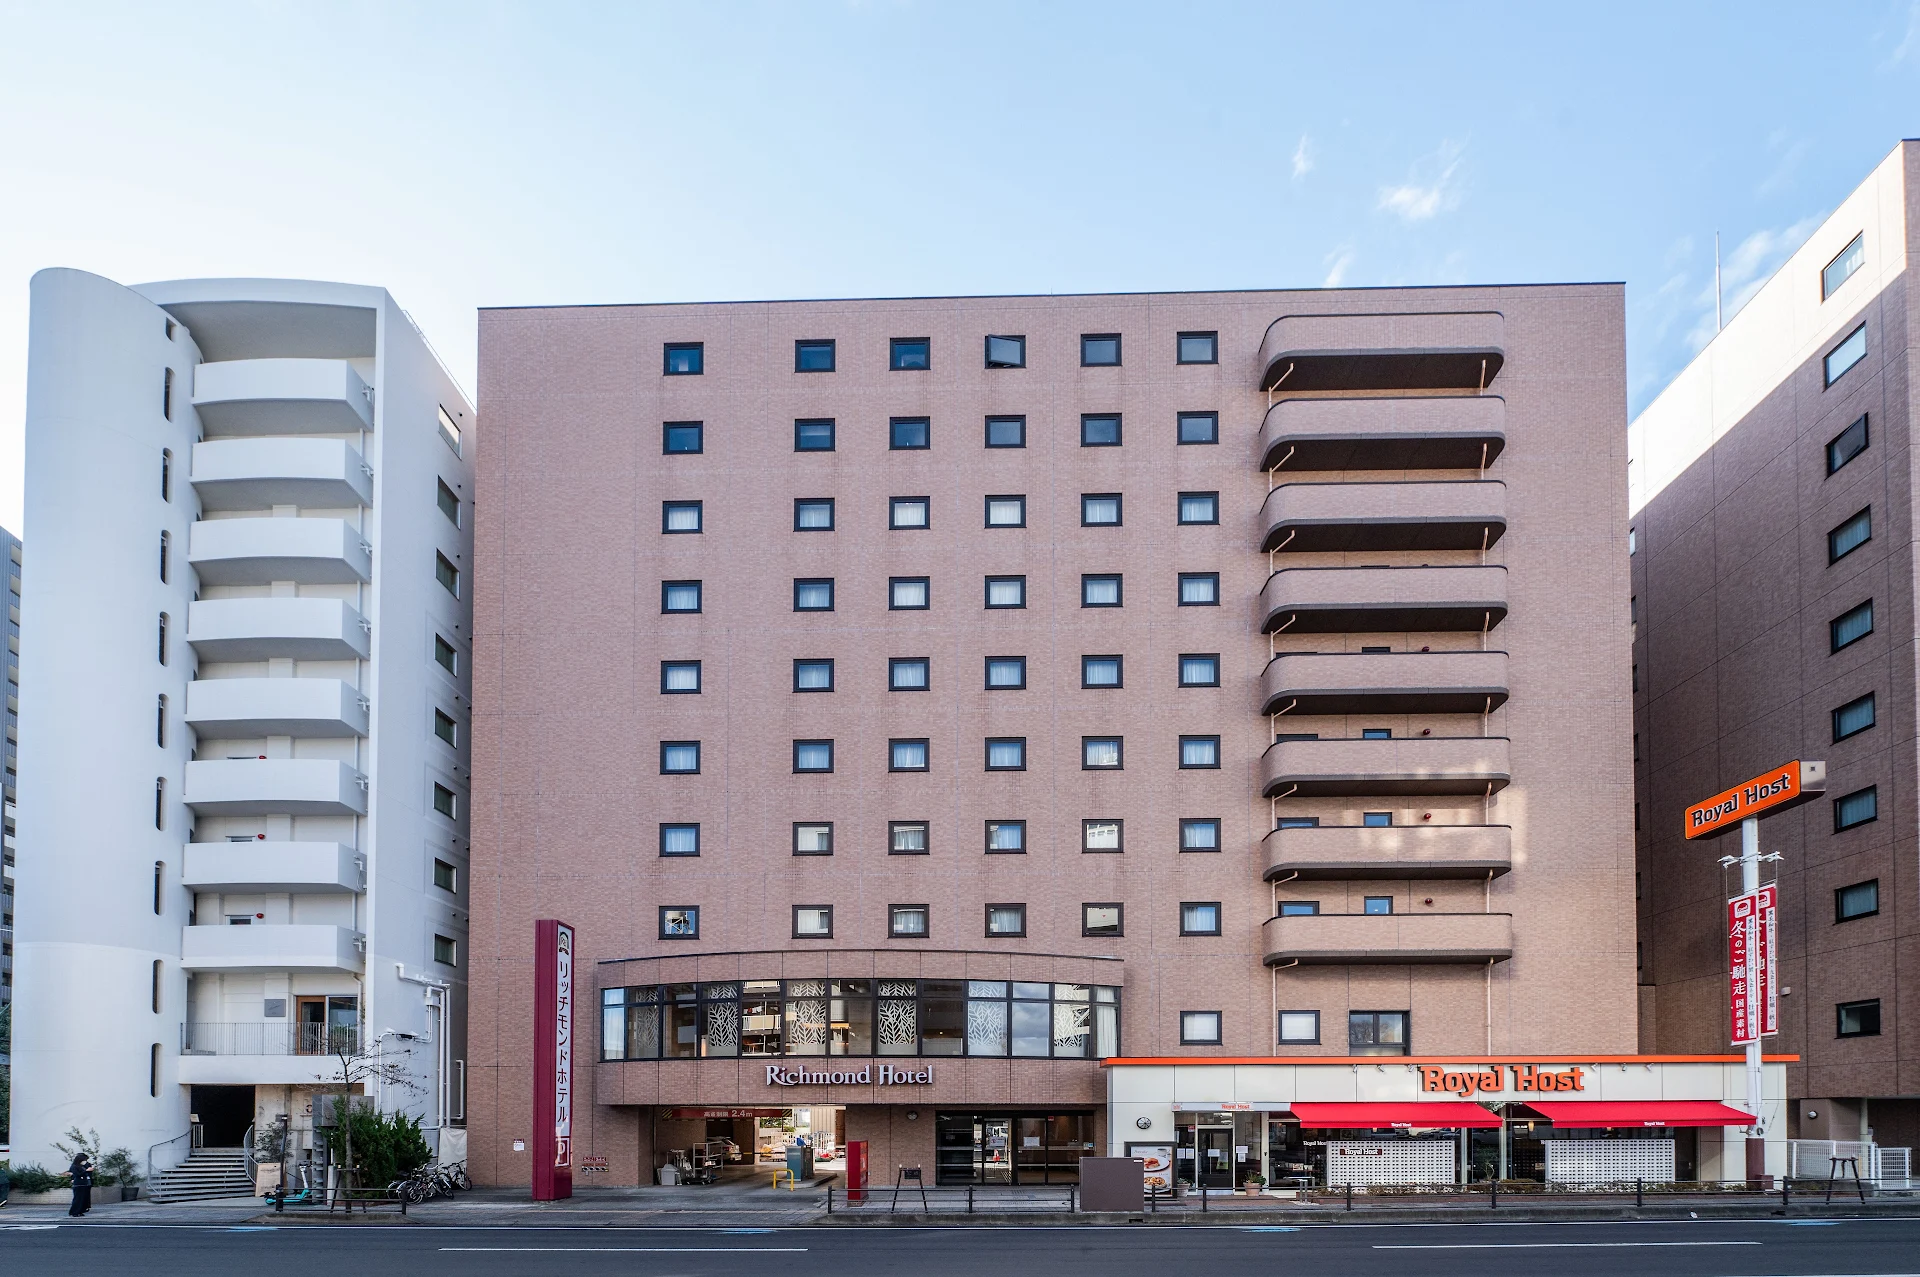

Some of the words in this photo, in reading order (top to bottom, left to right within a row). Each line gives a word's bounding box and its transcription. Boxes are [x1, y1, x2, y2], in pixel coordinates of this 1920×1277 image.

[1691, 792, 1739, 828] Royal
[1743, 772, 1791, 806] Host
[1730, 920, 1747, 996] 冬のご馳走
[557, 961, 569, 1123] リッチモンドホテル
[765, 1064, 872, 1086] Richmond
[878, 1064, 933, 1086] Hotel
[1418, 1065, 1505, 1097] Royal
[1511, 1065, 1585, 1092] Host
[557, 1142, 566, 1165] P
[1344, 1148, 1362, 1156] Royal
